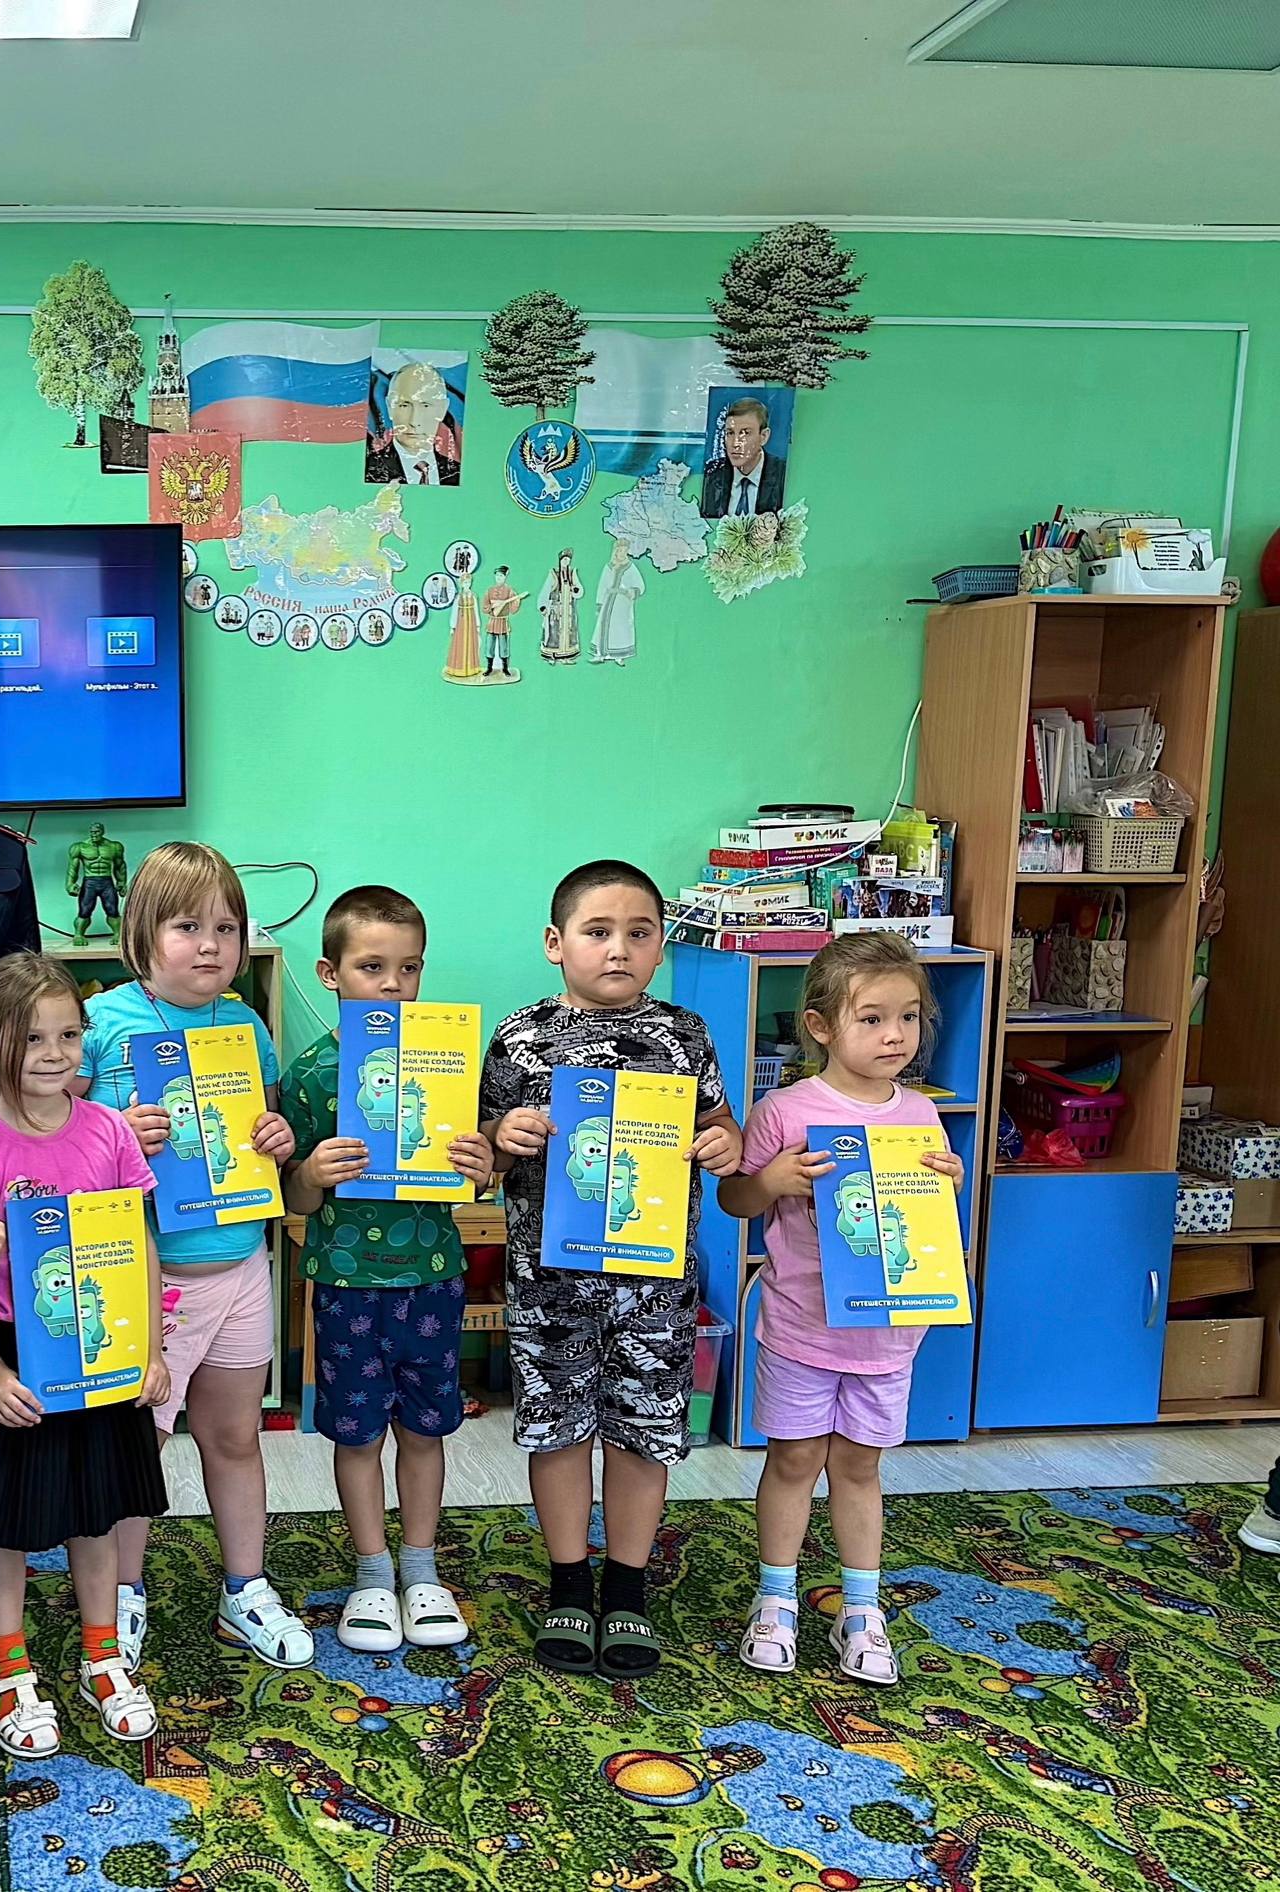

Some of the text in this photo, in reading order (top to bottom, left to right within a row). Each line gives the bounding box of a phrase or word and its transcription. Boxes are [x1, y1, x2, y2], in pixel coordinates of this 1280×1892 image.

[314, 603, 349, 613] наша
[728, 832, 750, 844] ТОМИК
[794, 828, 848, 842] ТОМИК
[754, 895, 790, 907] ТОМИК
[195, 1073, 226, 1081] ИСТОРИЯ
[222, 1079, 252, 1087] СОЗДАТЬ
[198, 1087, 253, 1098] МОНСТРОФОНА
[616, 1120, 652, 1129] ИСТОРИЯ
[645, 1131, 680, 1140] СОЗДАТЬ
[615, 1137, 678, 1148] МОНСТРОФОНА
[75, 1243, 108, 1252] ИСТОРИЯ
[566, 1244, 670, 1258] ПУТЕШЕСТВУЙ ВНИМАТЕЛЬНО!
[76, 1253, 91, 1261] КАК
[104, 1249, 136, 1258] СОЗДАТЬ
[77, 1257, 136, 1270] МОНСТРОФОНА
[851, 1299, 900, 1307] ПУТЕШЕСТВУЙ
[46, 1378, 96, 1393] ПУТЕШЕСТВУЙ
